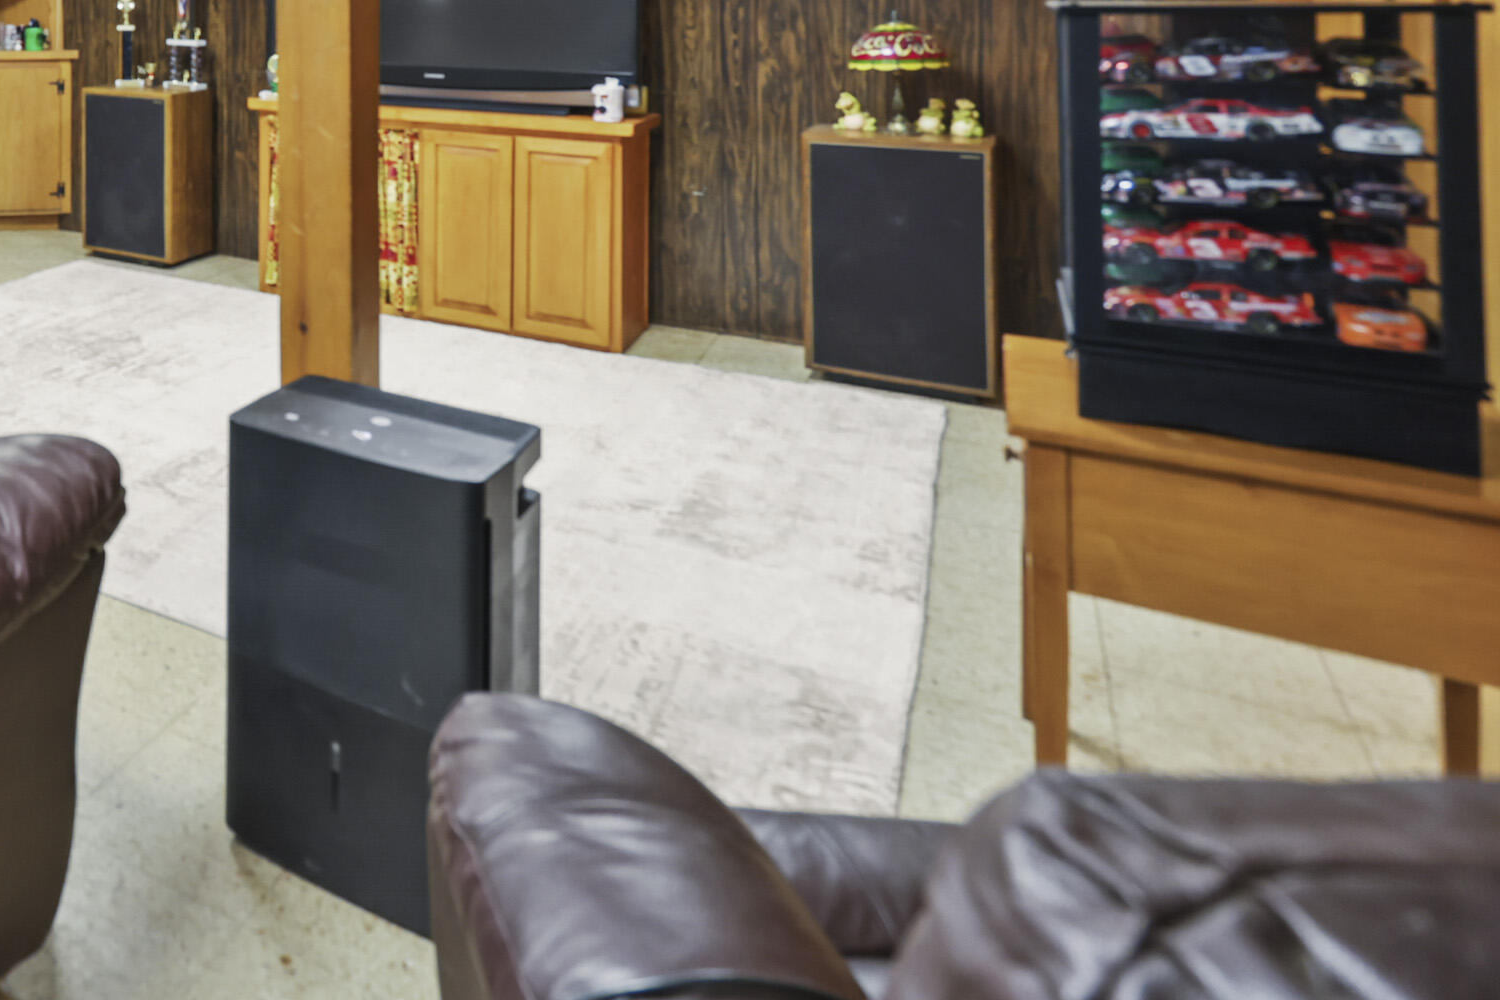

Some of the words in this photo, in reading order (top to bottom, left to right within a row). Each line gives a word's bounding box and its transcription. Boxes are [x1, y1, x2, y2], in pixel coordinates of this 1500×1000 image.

[1186, 178, 1224, 199] 3
[1188, 238, 1223, 259] 3
[1185, 300, 1219, 321] 3
